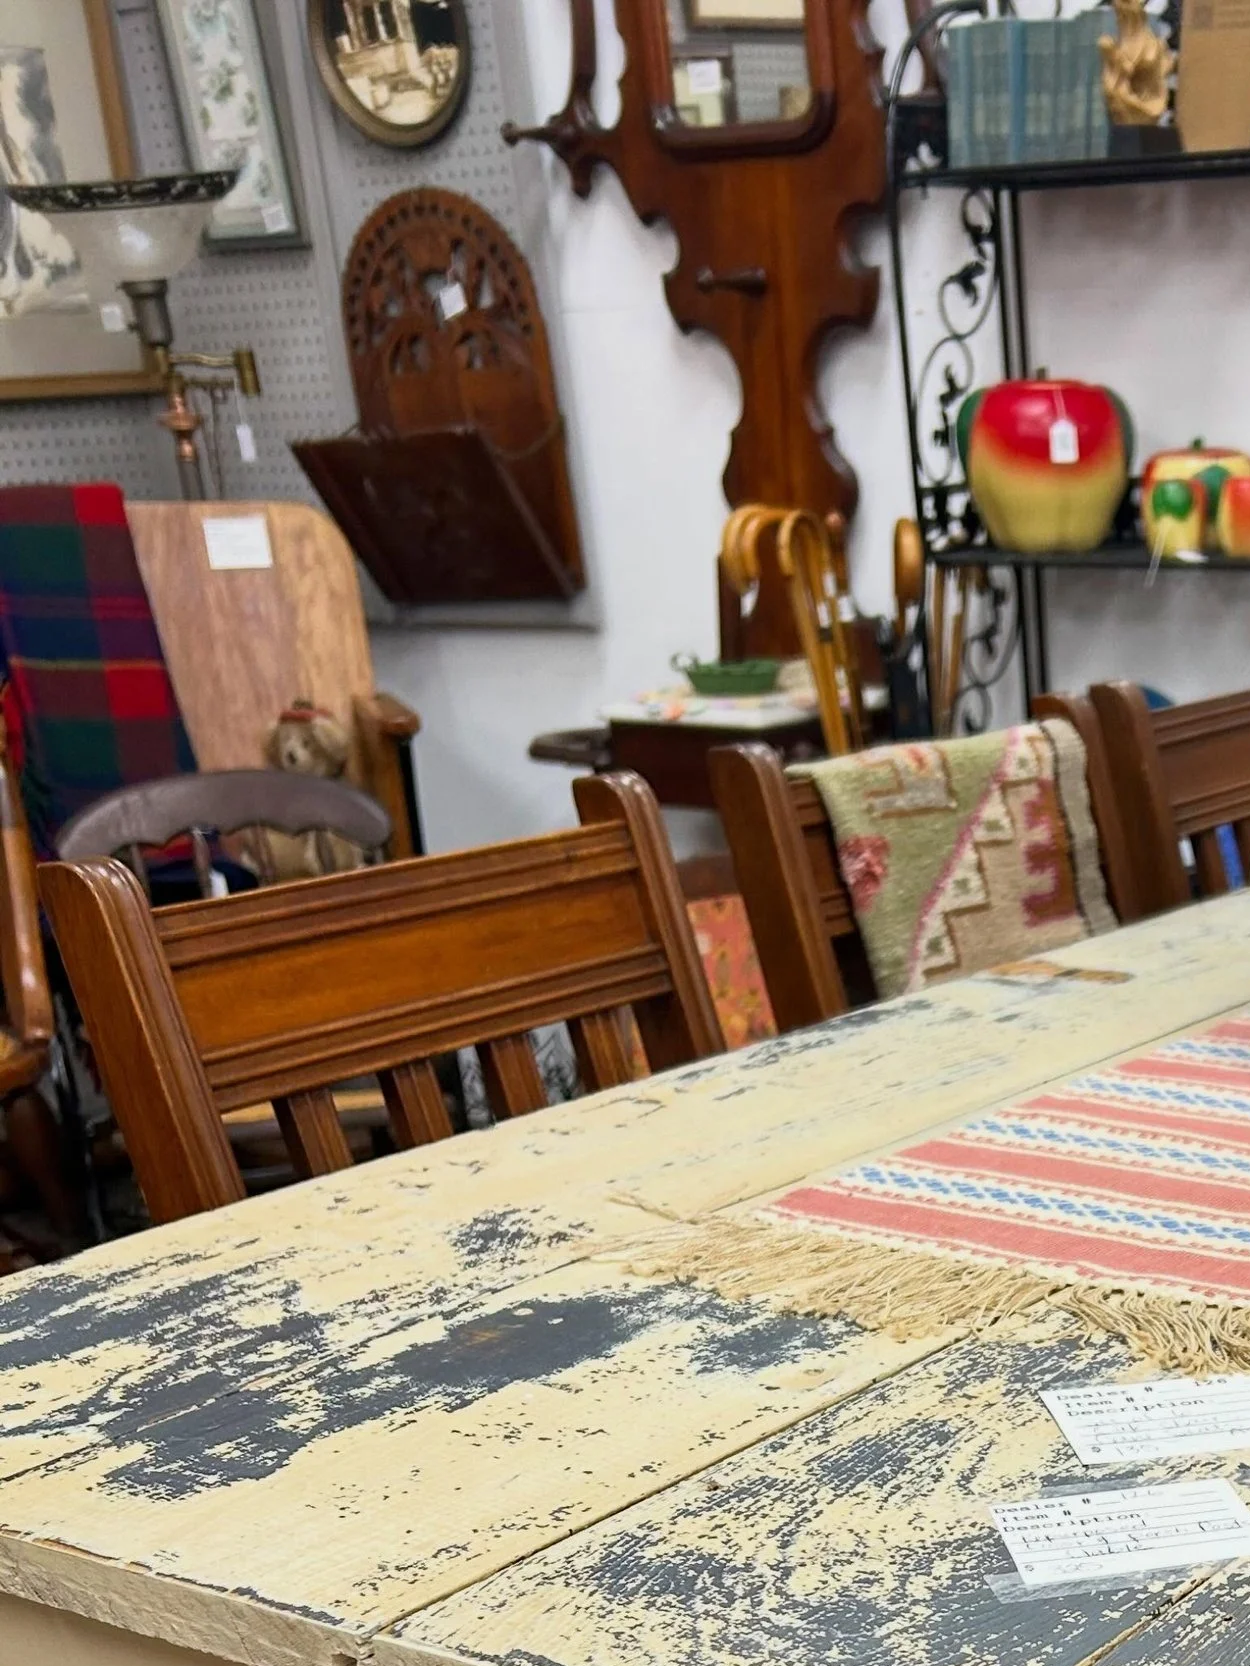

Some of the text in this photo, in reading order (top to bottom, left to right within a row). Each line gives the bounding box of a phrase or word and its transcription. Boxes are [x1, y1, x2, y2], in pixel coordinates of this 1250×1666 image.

[1056, 1389, 1129, 1401] Dealer
[1064, 1400, 1113, 1409] Item
[1067, 1399, 1206, 1417] Description
[993, 1502, 1068, 1515] Dealer
[1001, 1512, 1049, 1523] Item
[1002, 1513, 1143, 1533] Description
